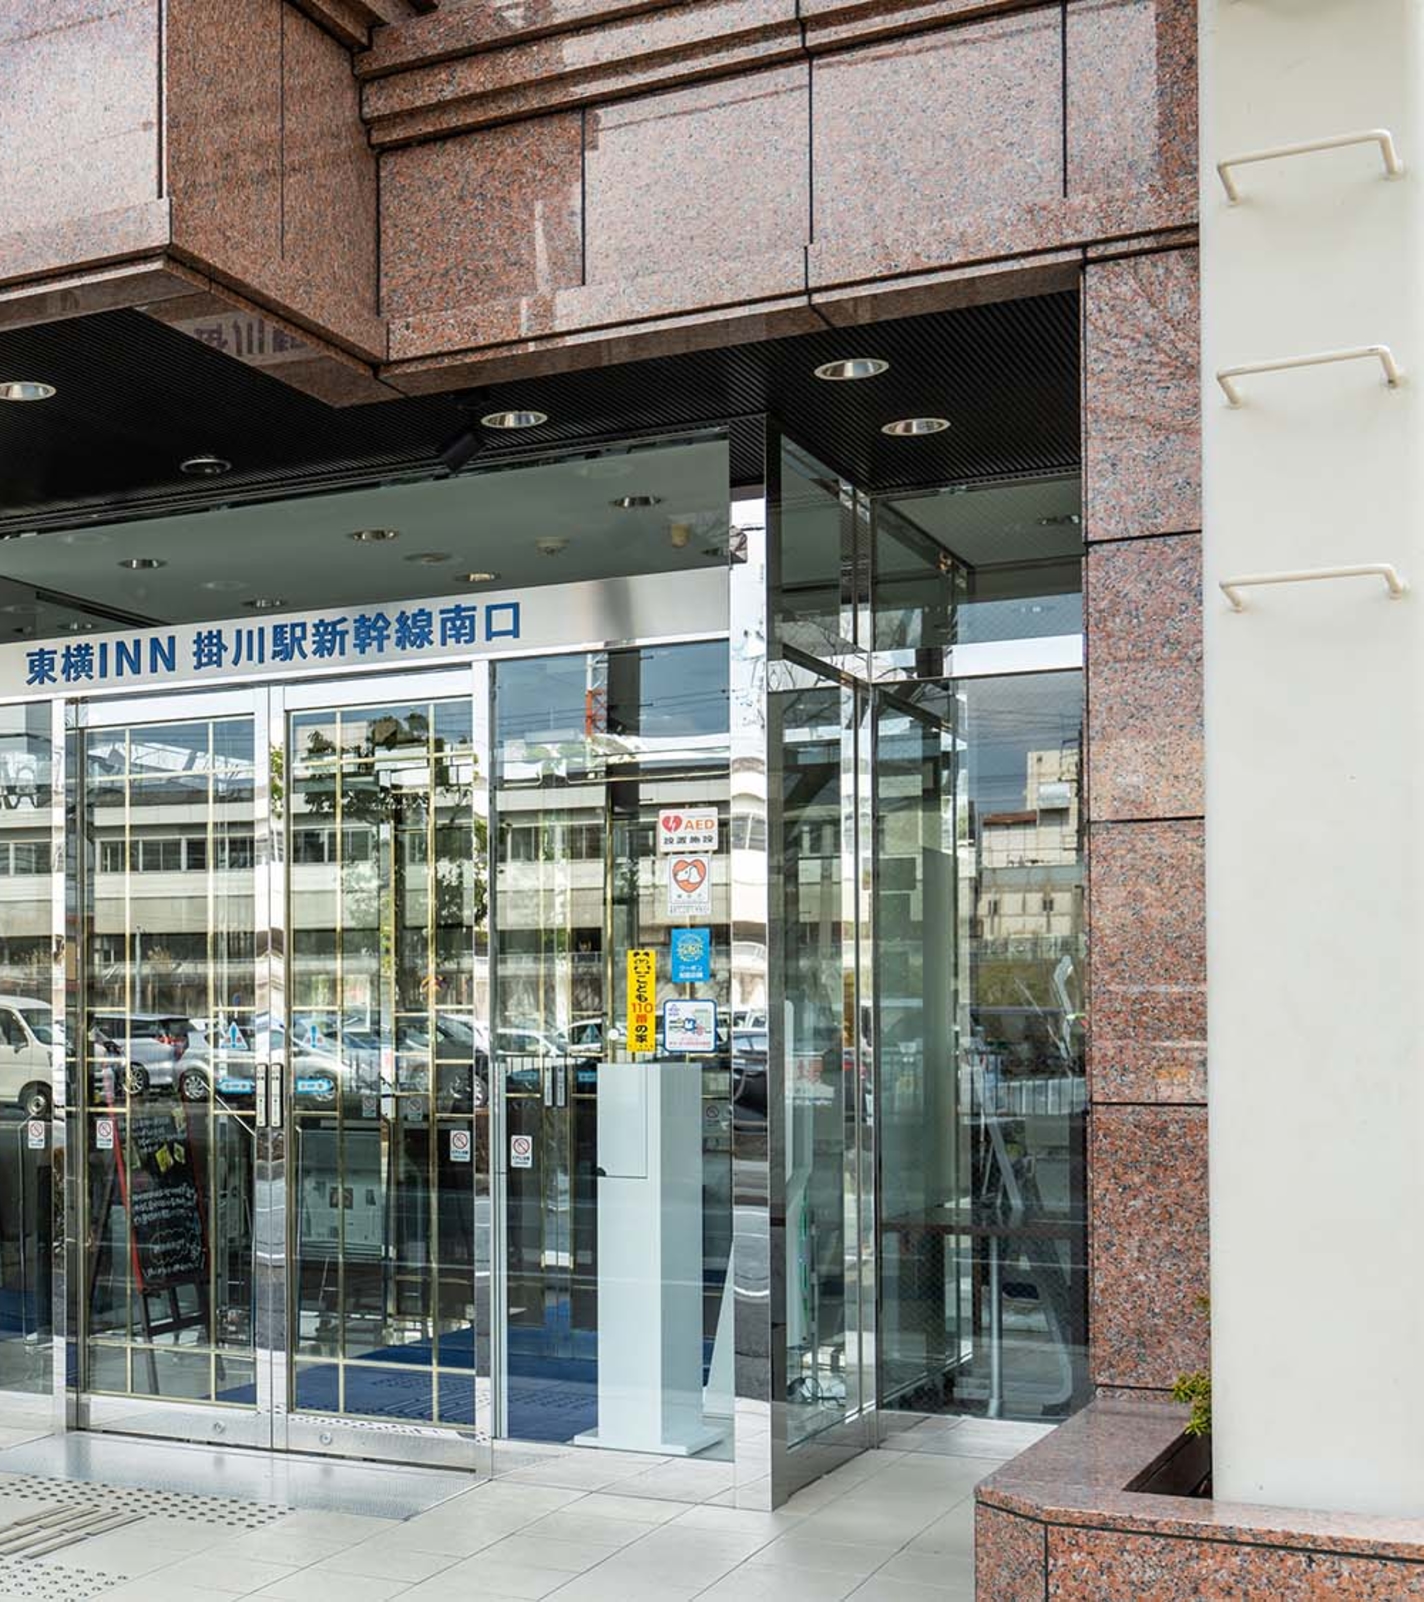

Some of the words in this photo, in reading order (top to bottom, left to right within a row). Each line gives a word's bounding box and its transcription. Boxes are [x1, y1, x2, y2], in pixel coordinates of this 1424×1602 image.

[25, 634, 177, 687] 東横INN
[192, 600, 522, 670] 掛川駅新幹線南口
[684, 819, 715, 831] AED
